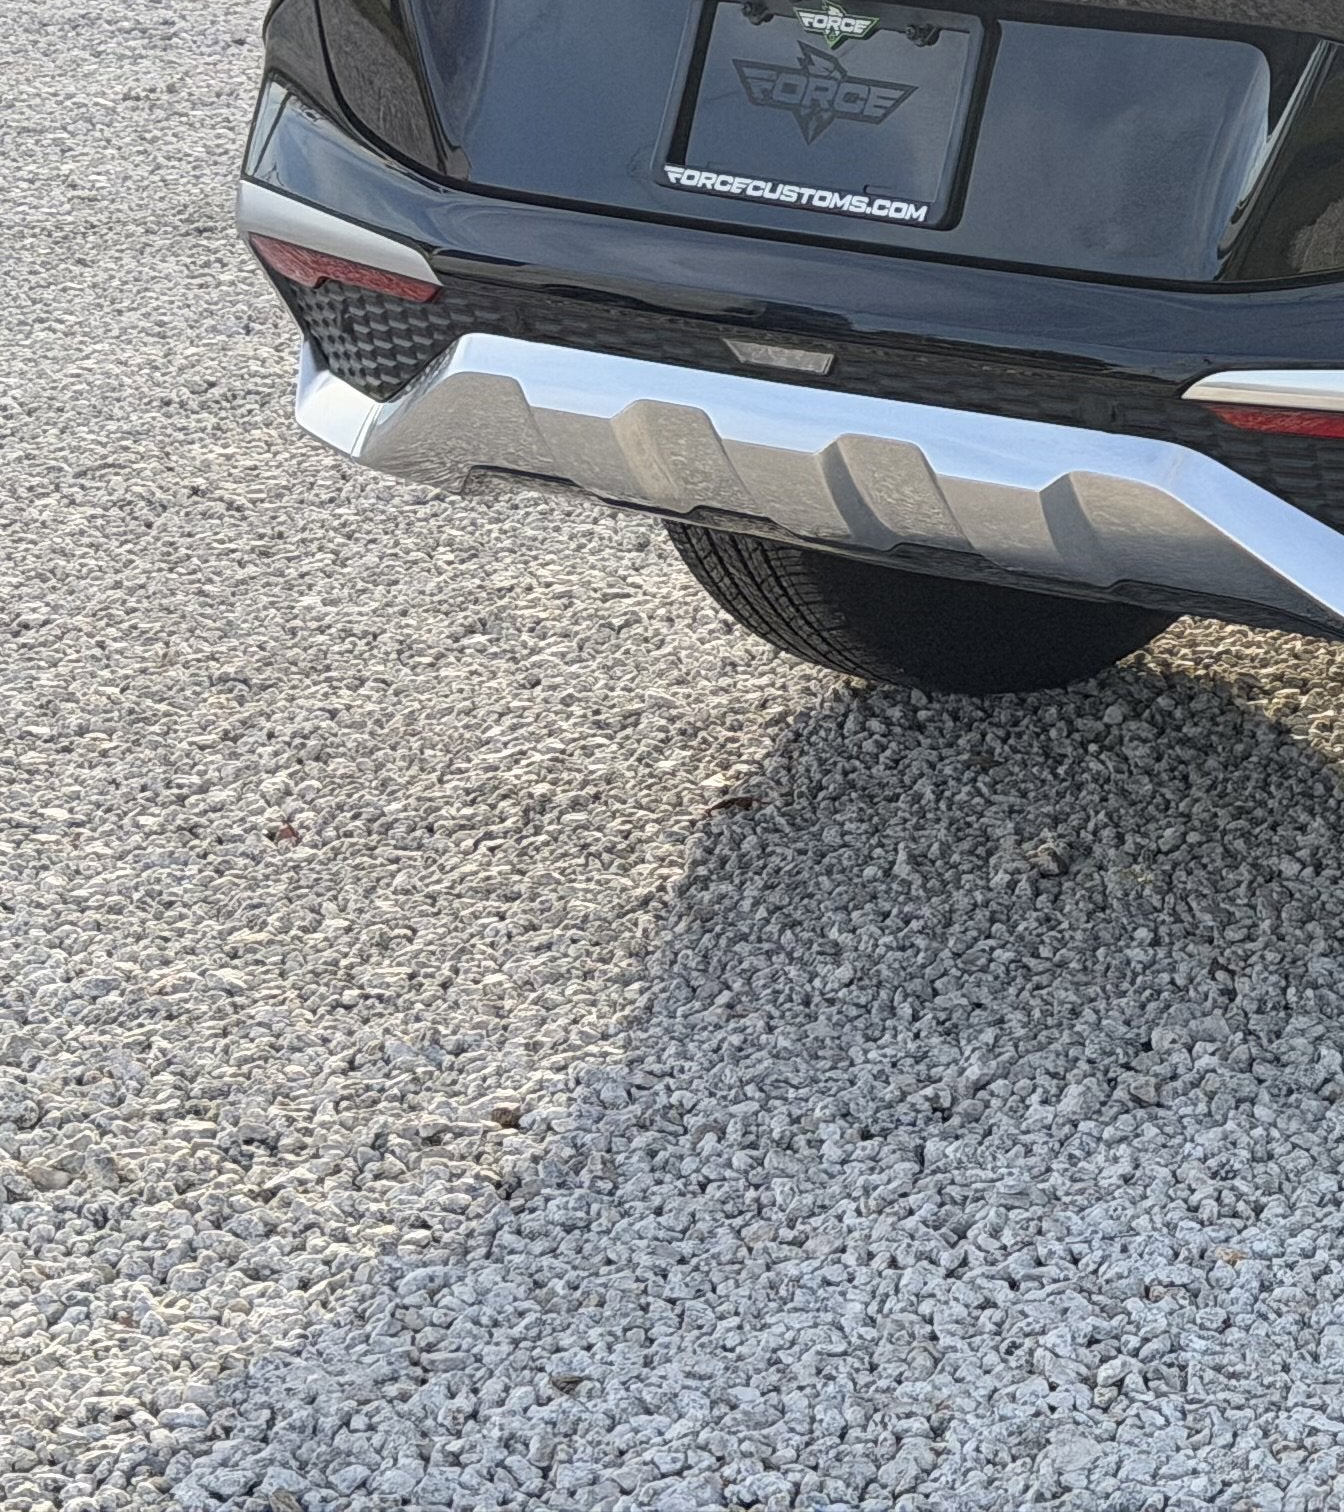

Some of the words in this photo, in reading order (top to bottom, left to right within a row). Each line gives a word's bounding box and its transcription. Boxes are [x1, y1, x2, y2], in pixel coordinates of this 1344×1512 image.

[798, 11, 873, 35] FORCE
[742, 66, 906, 119] FORCE
[664, 165, 928, 223] FORCECUSTOMS.COM
